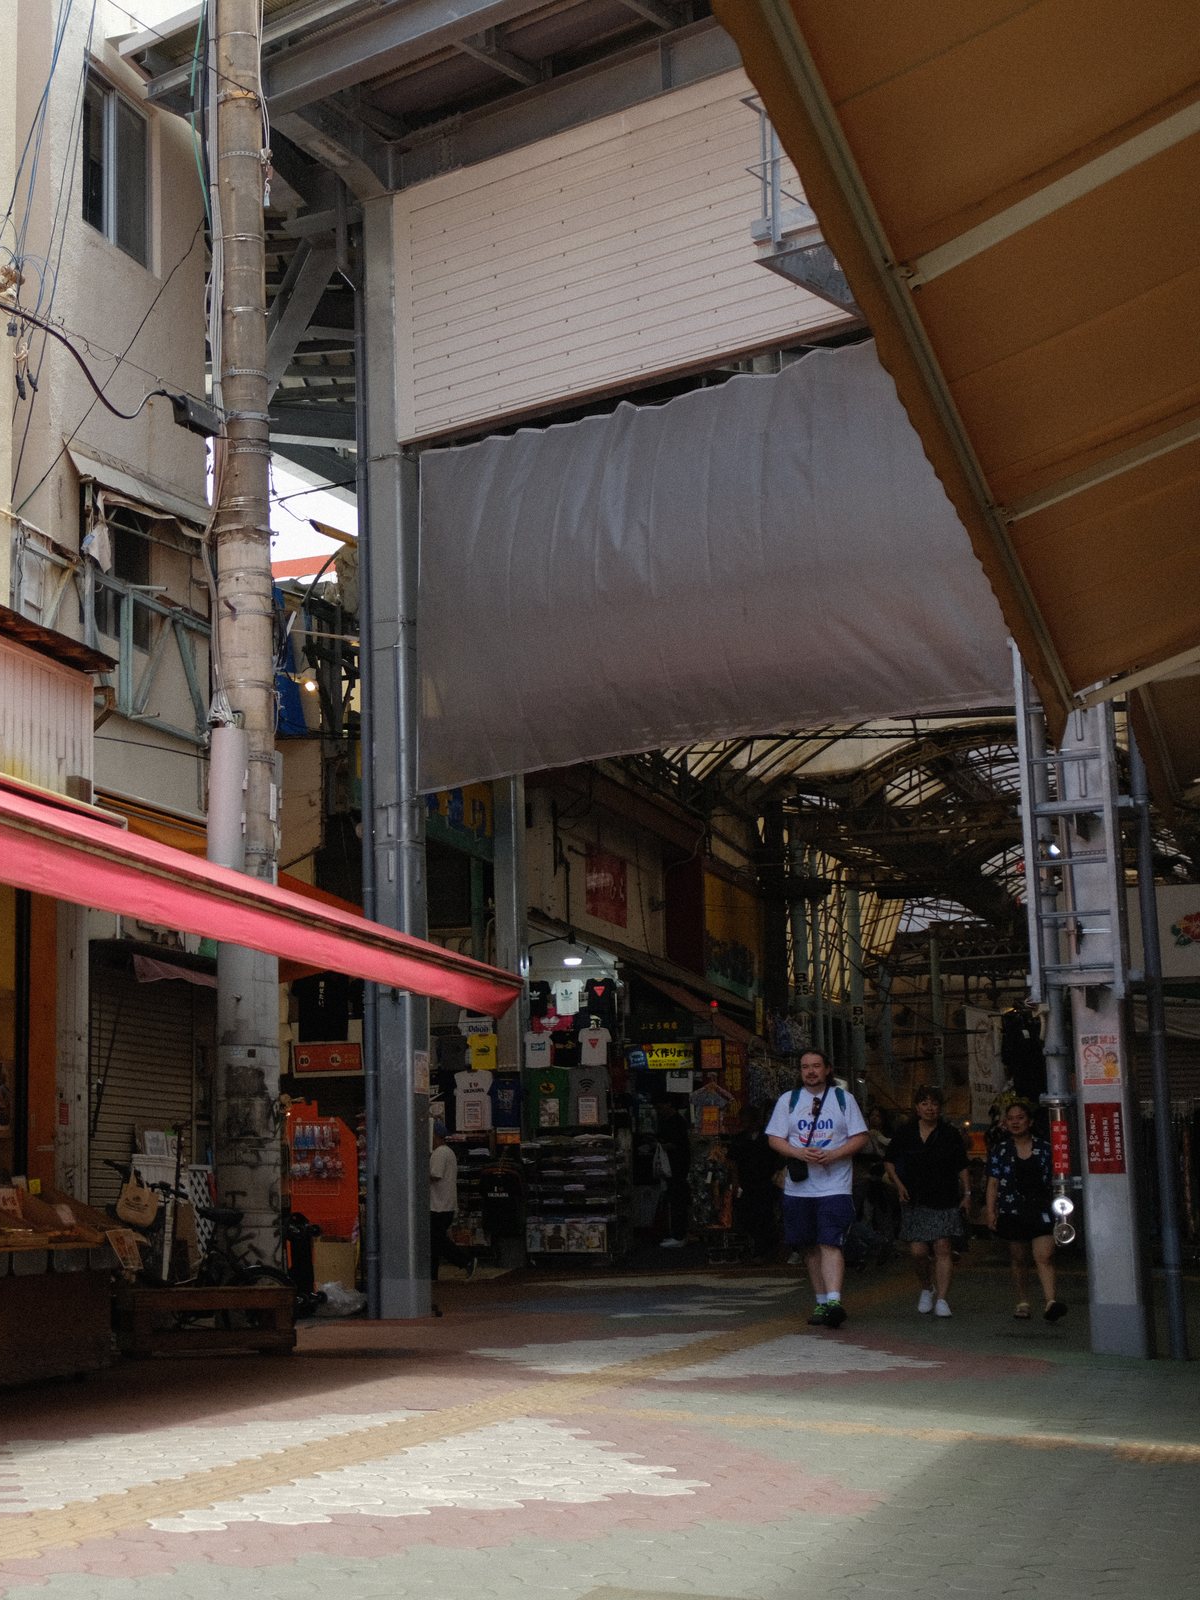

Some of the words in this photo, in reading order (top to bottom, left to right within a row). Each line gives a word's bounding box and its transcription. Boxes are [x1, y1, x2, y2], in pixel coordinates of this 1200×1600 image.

[795, 973, 807, 983] B
[796, 985, 809, 995] 25
[853, 1006, 864, 1015] B
[852, 1016, 864, 1026] 24
[798, 1119, 833, 1131] Oron
